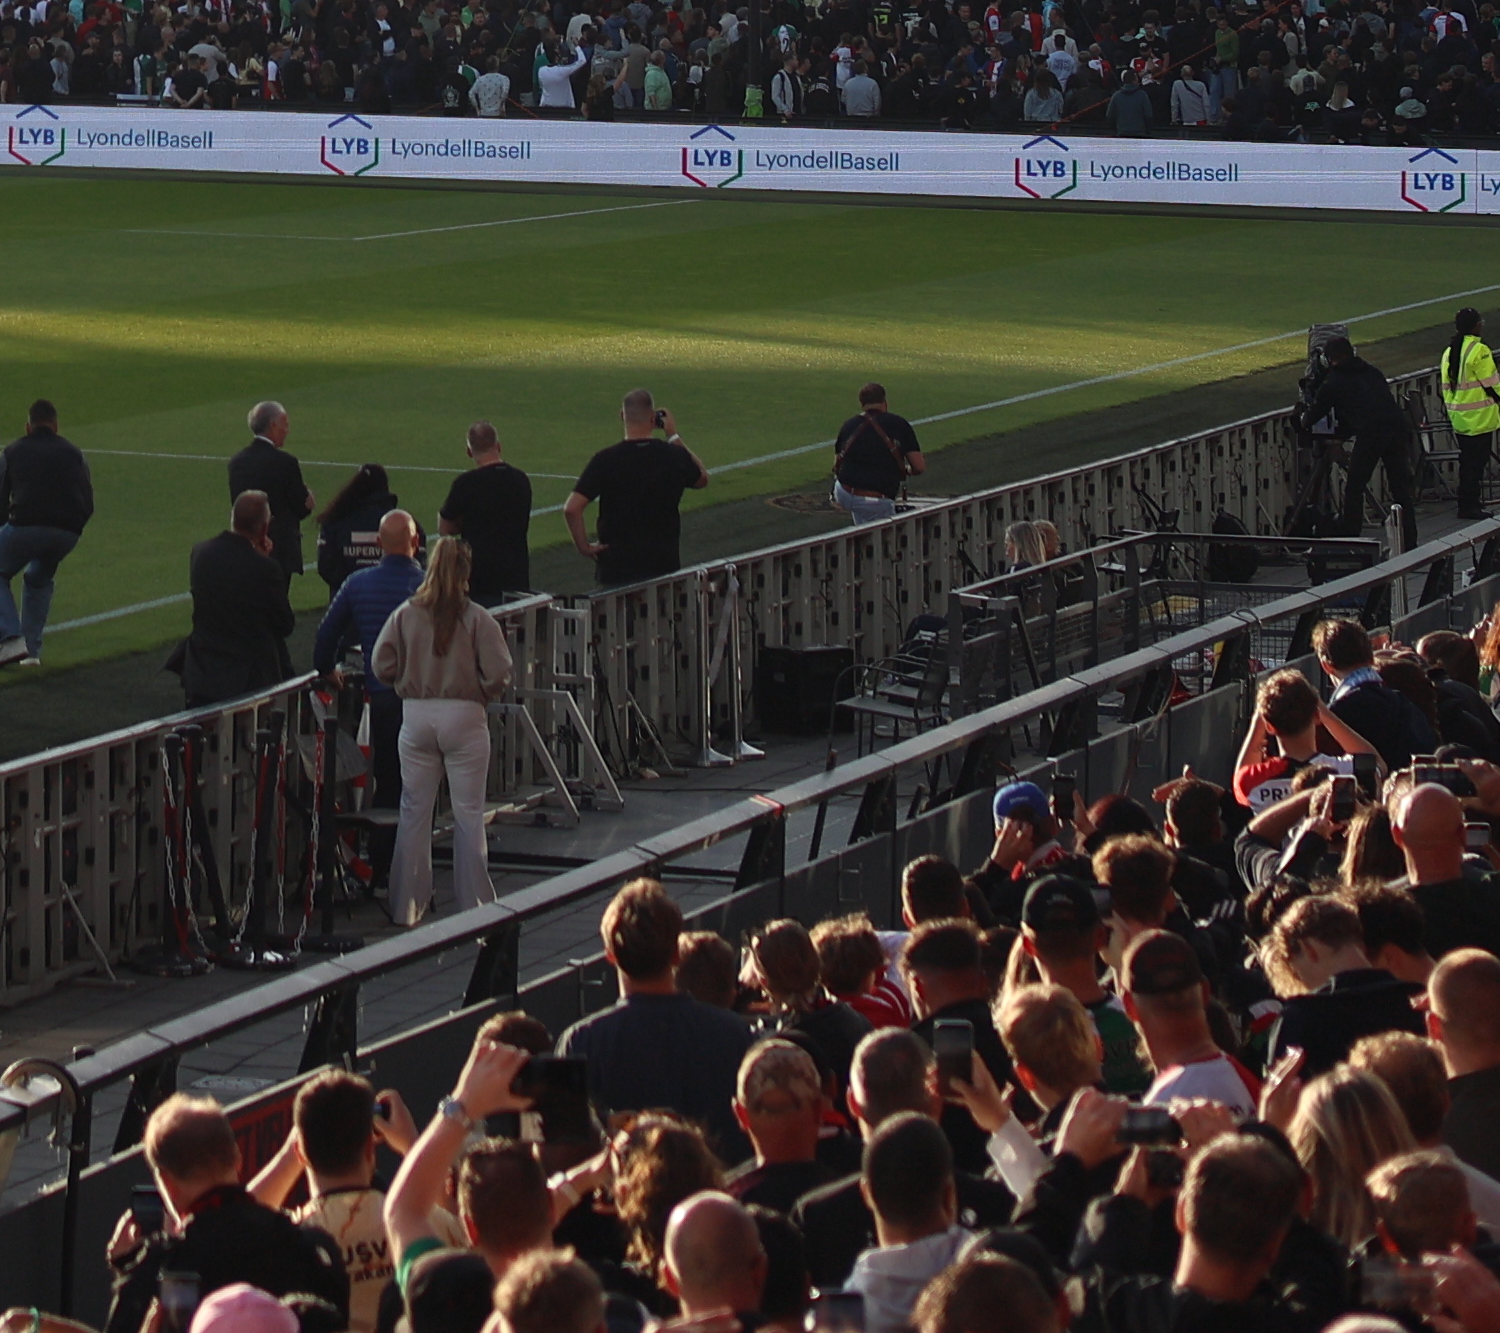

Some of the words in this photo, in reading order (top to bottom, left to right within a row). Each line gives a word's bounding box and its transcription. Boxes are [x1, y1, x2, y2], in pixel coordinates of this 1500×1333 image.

[17, 128, 55, 146] LYB
[76, 127, 214, 151] LyondellBasell
[330, 137, 370, 155] LYB
[391, 136, 532, 162] LyondellBasell
[692, 149, 732, 168] LYB
[755, 148, 900, 174] LyondellBasell
[1025, 160, 1066, 179] LYB
[1089, 160, 1239, 186] LyondellBasell
[1413, 173, 1455, 192] LYB
[342, 544, 382, 558] SUPERV
